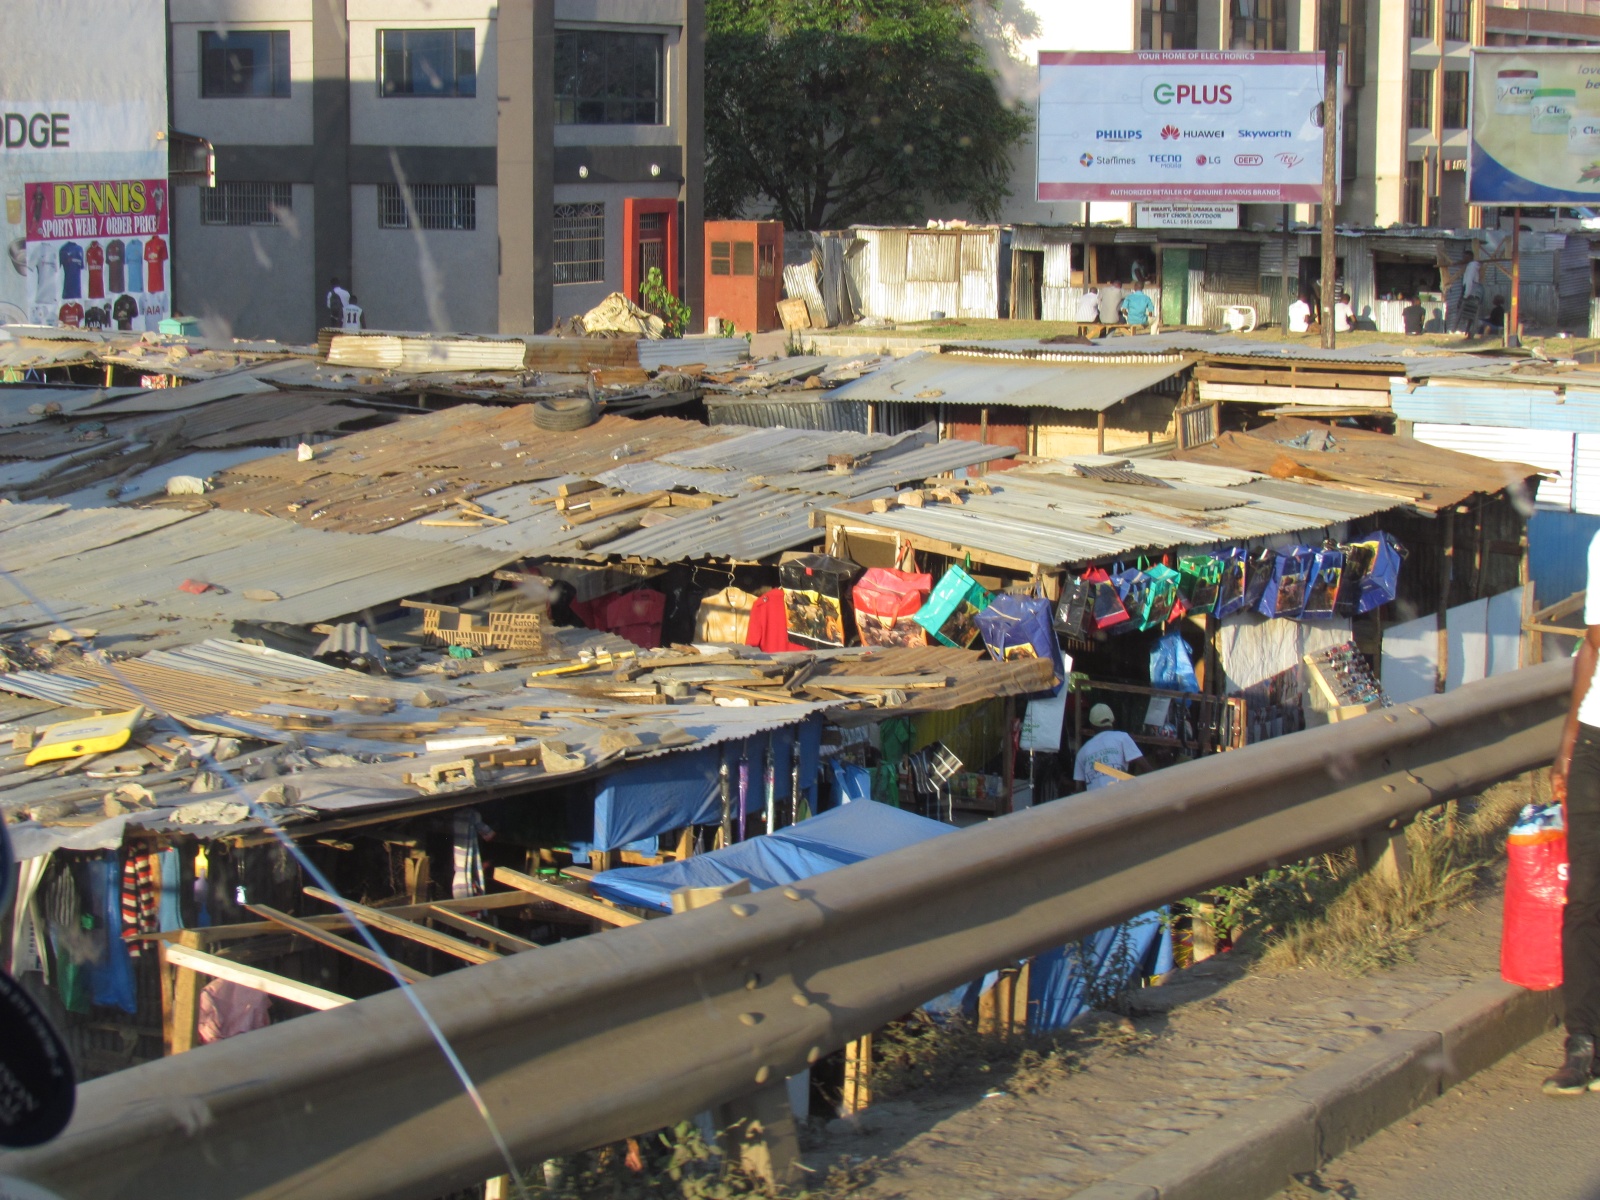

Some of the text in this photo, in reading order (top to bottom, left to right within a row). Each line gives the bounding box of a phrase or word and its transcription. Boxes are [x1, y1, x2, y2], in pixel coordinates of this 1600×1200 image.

[1163, 52, 1187, 60] HOME
[1188, 52, 1199, 60] OF
[1200, 52, 1255, 60] ELECTRONICS
[0, 112, 70, 149] DGE
[1096, 130, 1142, 139] PHILIPS
[1183, 130, 1225, 138] HUAWEI
[1238, 129, 1292, 139] Skyworth
[1096, 155, 1136, 165] StarTimes
[1148, 154, 1182, 163] TECNO
[1208, 156, 1221, 164] LG
[1238, 156, 1259, 164] DEFY
[53, 181, 147, 216] DENNIS
[42, 218, 74, 238] SPORTS
[74, 218, 98, 237] WEAR
[106, 216, 133, 234] ORDER
[134, 215, 158, 233] PRICE
[347, 312, 358, 324] 11
